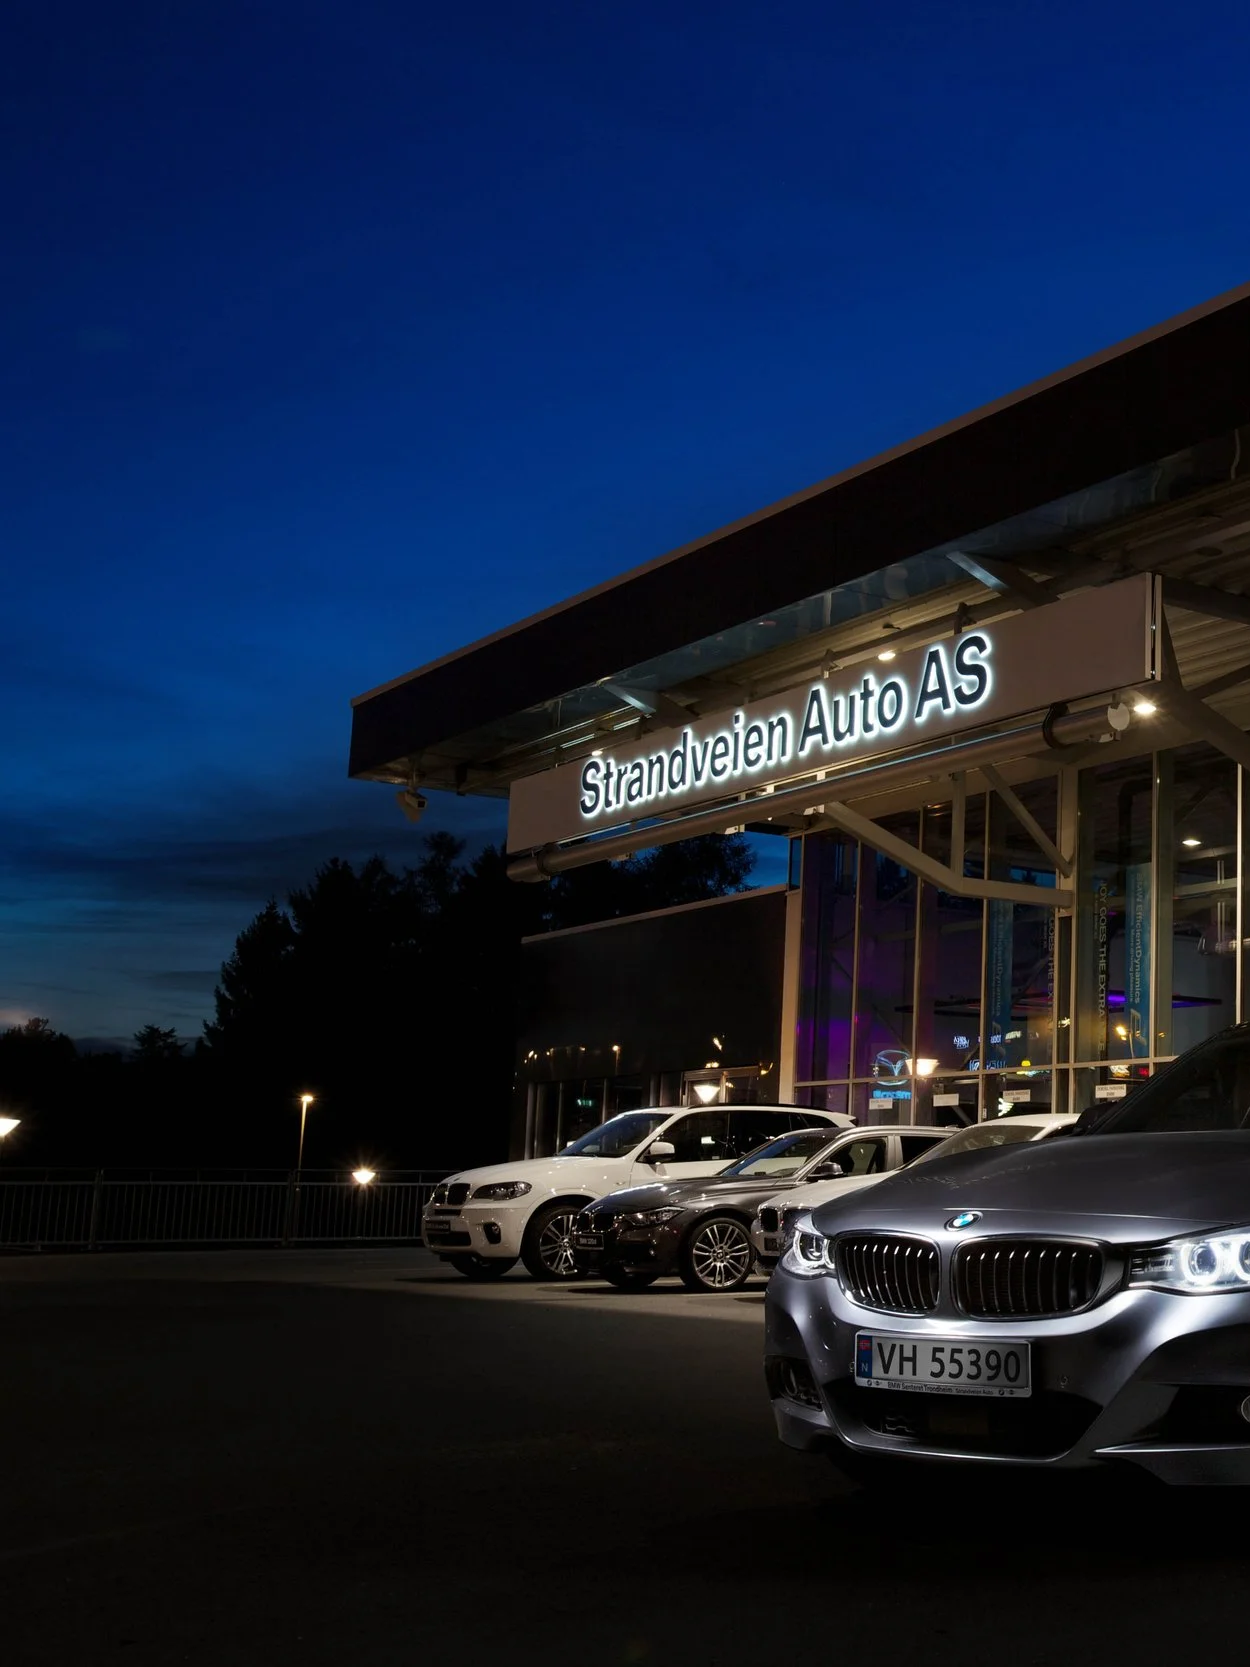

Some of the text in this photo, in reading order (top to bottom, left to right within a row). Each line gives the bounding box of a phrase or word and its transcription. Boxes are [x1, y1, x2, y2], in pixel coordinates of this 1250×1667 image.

[579, 634, 989, 816] Strandveien Auto AS
[1099, 906, 1107, 943] GOES
[1098, 944, 1107, 972] THE
[1133, 904, 1144, 1004] EfficientDynamics
[1098, 974, 1106, 1018] EXTRA
[861, 1342, 1021, 1383] N VH 55390
[887, 1381, 901, 1389] BMW
[924, 1384, 953, 1393] Trondheim
